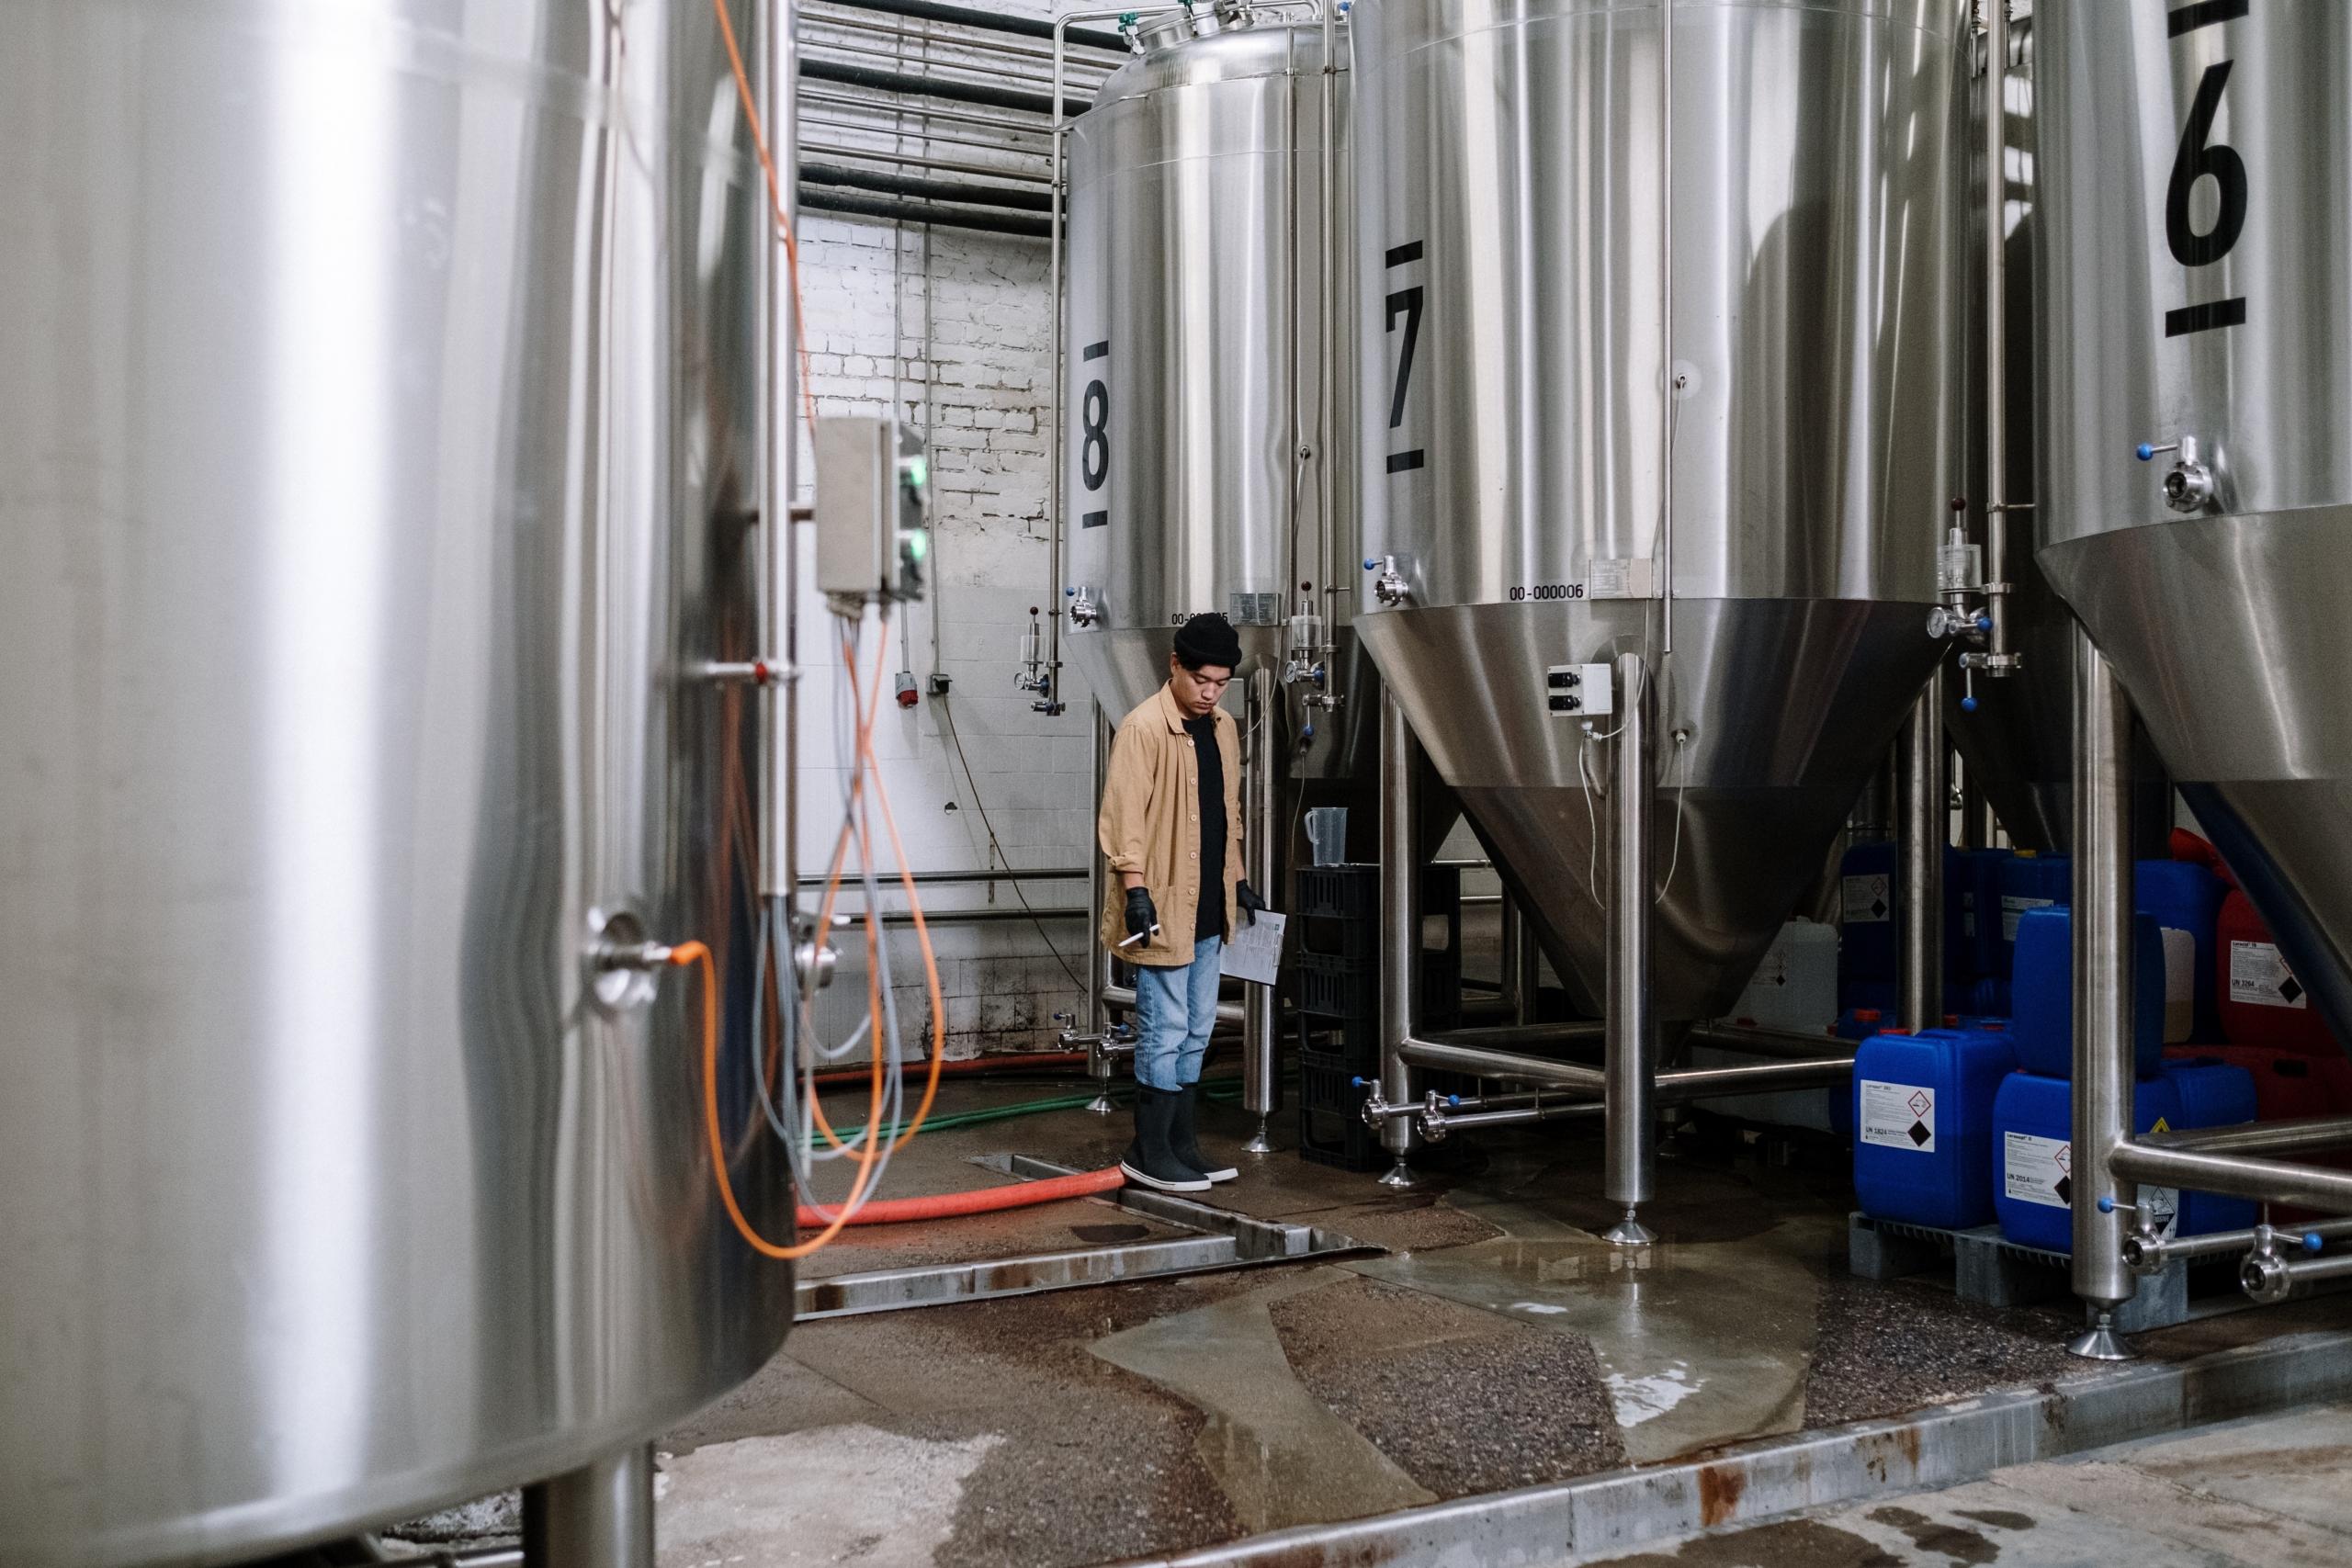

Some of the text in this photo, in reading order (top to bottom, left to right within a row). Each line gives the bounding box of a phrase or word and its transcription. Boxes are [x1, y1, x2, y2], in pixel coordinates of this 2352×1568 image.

[2165, 59, 2248, 267] 6
[1385, 285, 1423, 429] 7
[1082, 379, 1109, 491] 8
[1510, 584, 1584, 601] 00-000006
[1865, 1125, 1873, 1134] UN
[2007, 1172, 2015, 1180] UN
[2016, 1174, 2030, 1183] 2014
